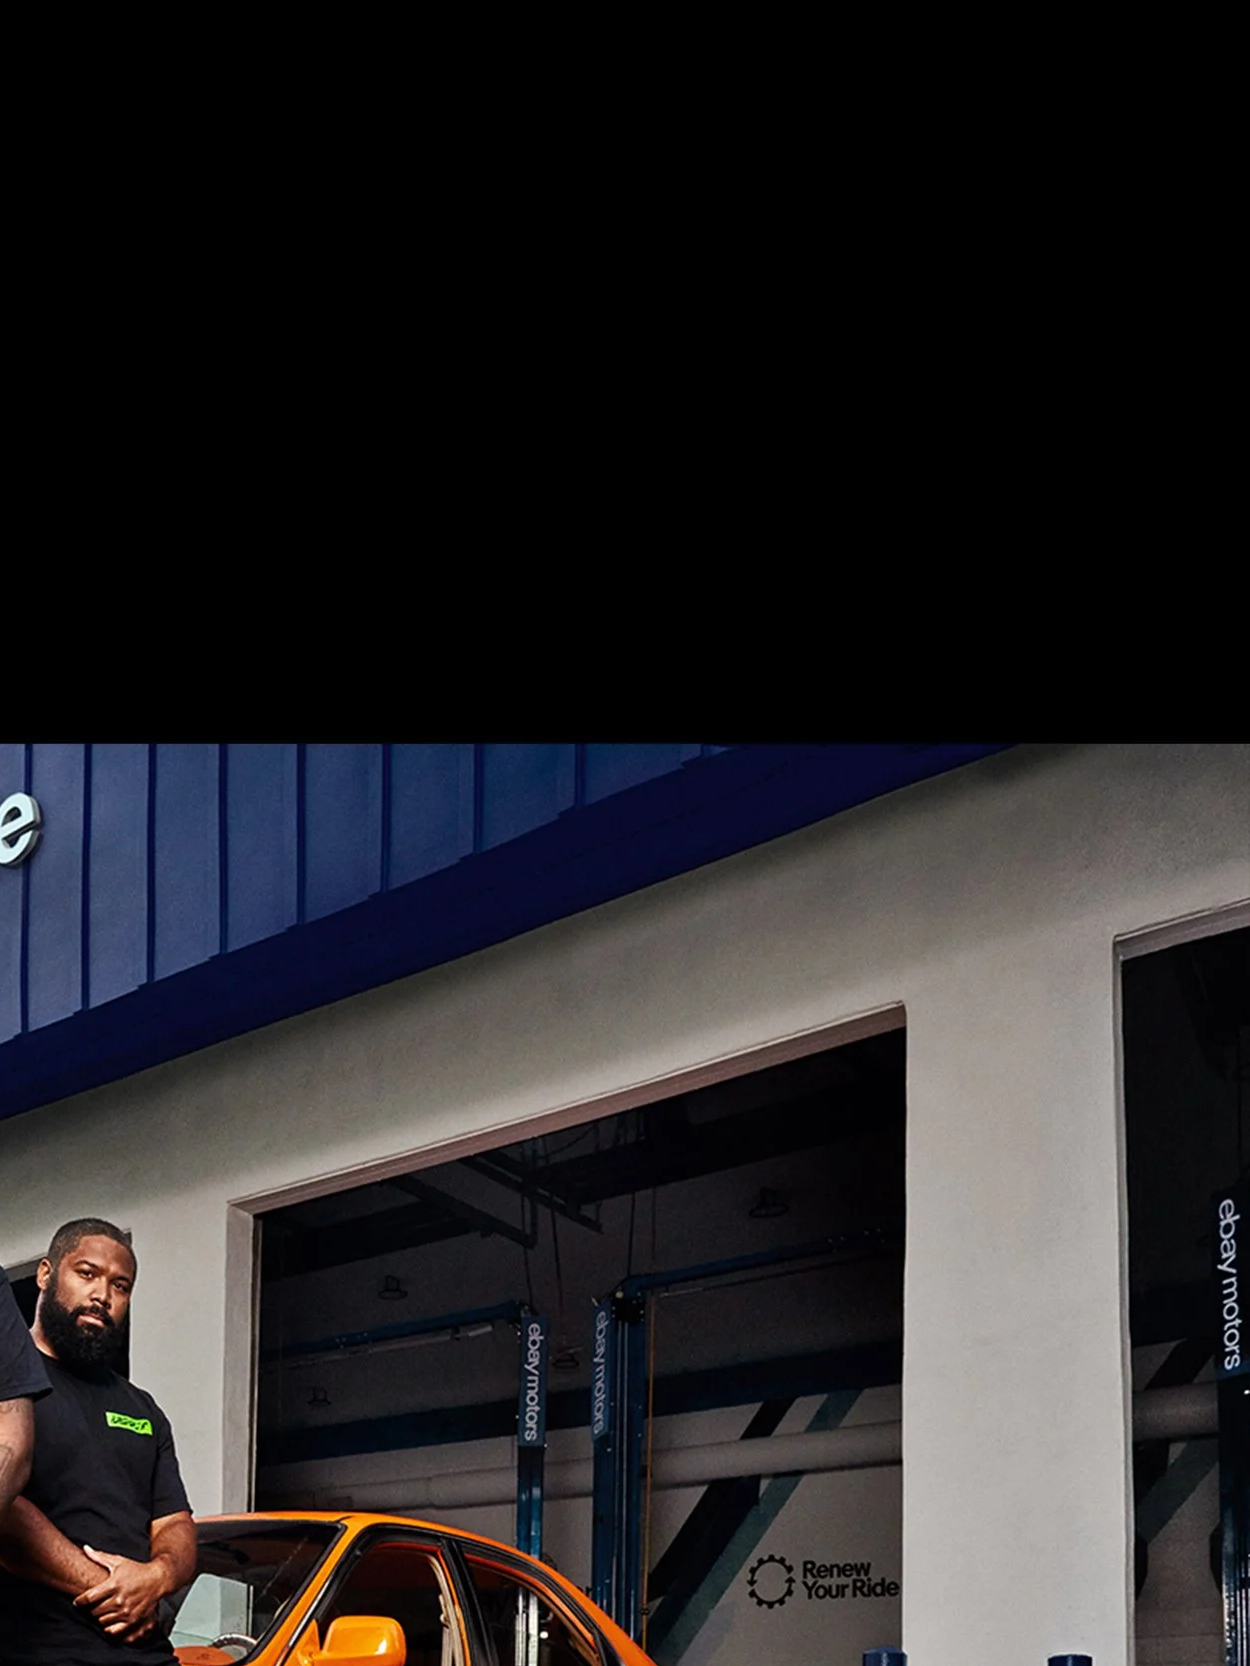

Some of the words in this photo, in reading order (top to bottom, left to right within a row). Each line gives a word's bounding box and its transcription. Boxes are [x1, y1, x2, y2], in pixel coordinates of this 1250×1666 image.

[802, 1560, 871, 1578] Renew
[802, 1580, 849, 1599] Your
[853, 1577, 900, 1598] Ride
